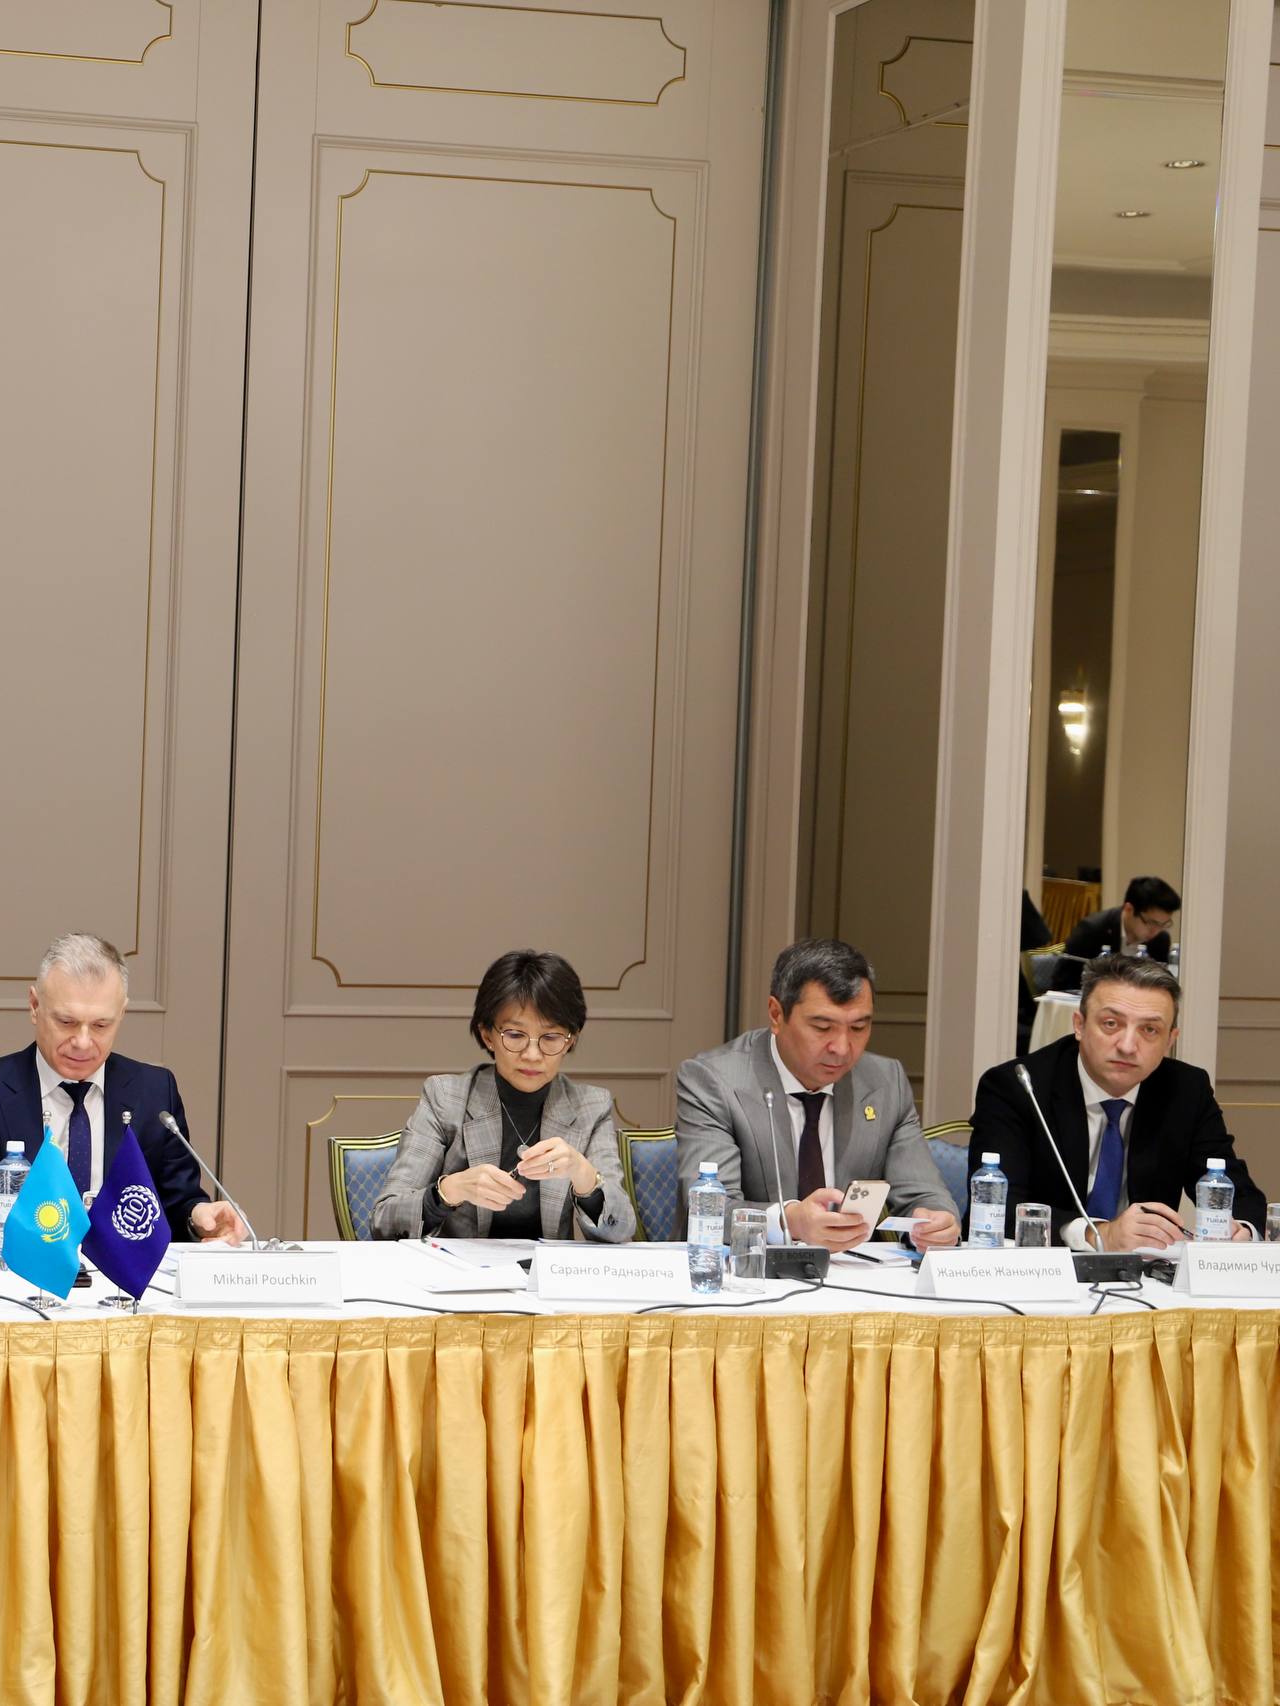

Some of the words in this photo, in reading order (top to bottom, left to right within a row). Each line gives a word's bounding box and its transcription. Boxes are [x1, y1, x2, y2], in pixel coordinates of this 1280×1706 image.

[123, 1198, 147, 1225] ILO
[550, 1263, 600, 1276] Саранго
[603, 1264, 674, 1279] Раднарагча
[937, 1266, 992, 1278] Жаныбек
[994, 1266, 1062, 1279] Жаныкулов
[1198, 1259, 1258, 1273] Владимир
[213, 1273, 258, 1285] Mikhail
[262, 1273, 317, 1286] Pouchkin
